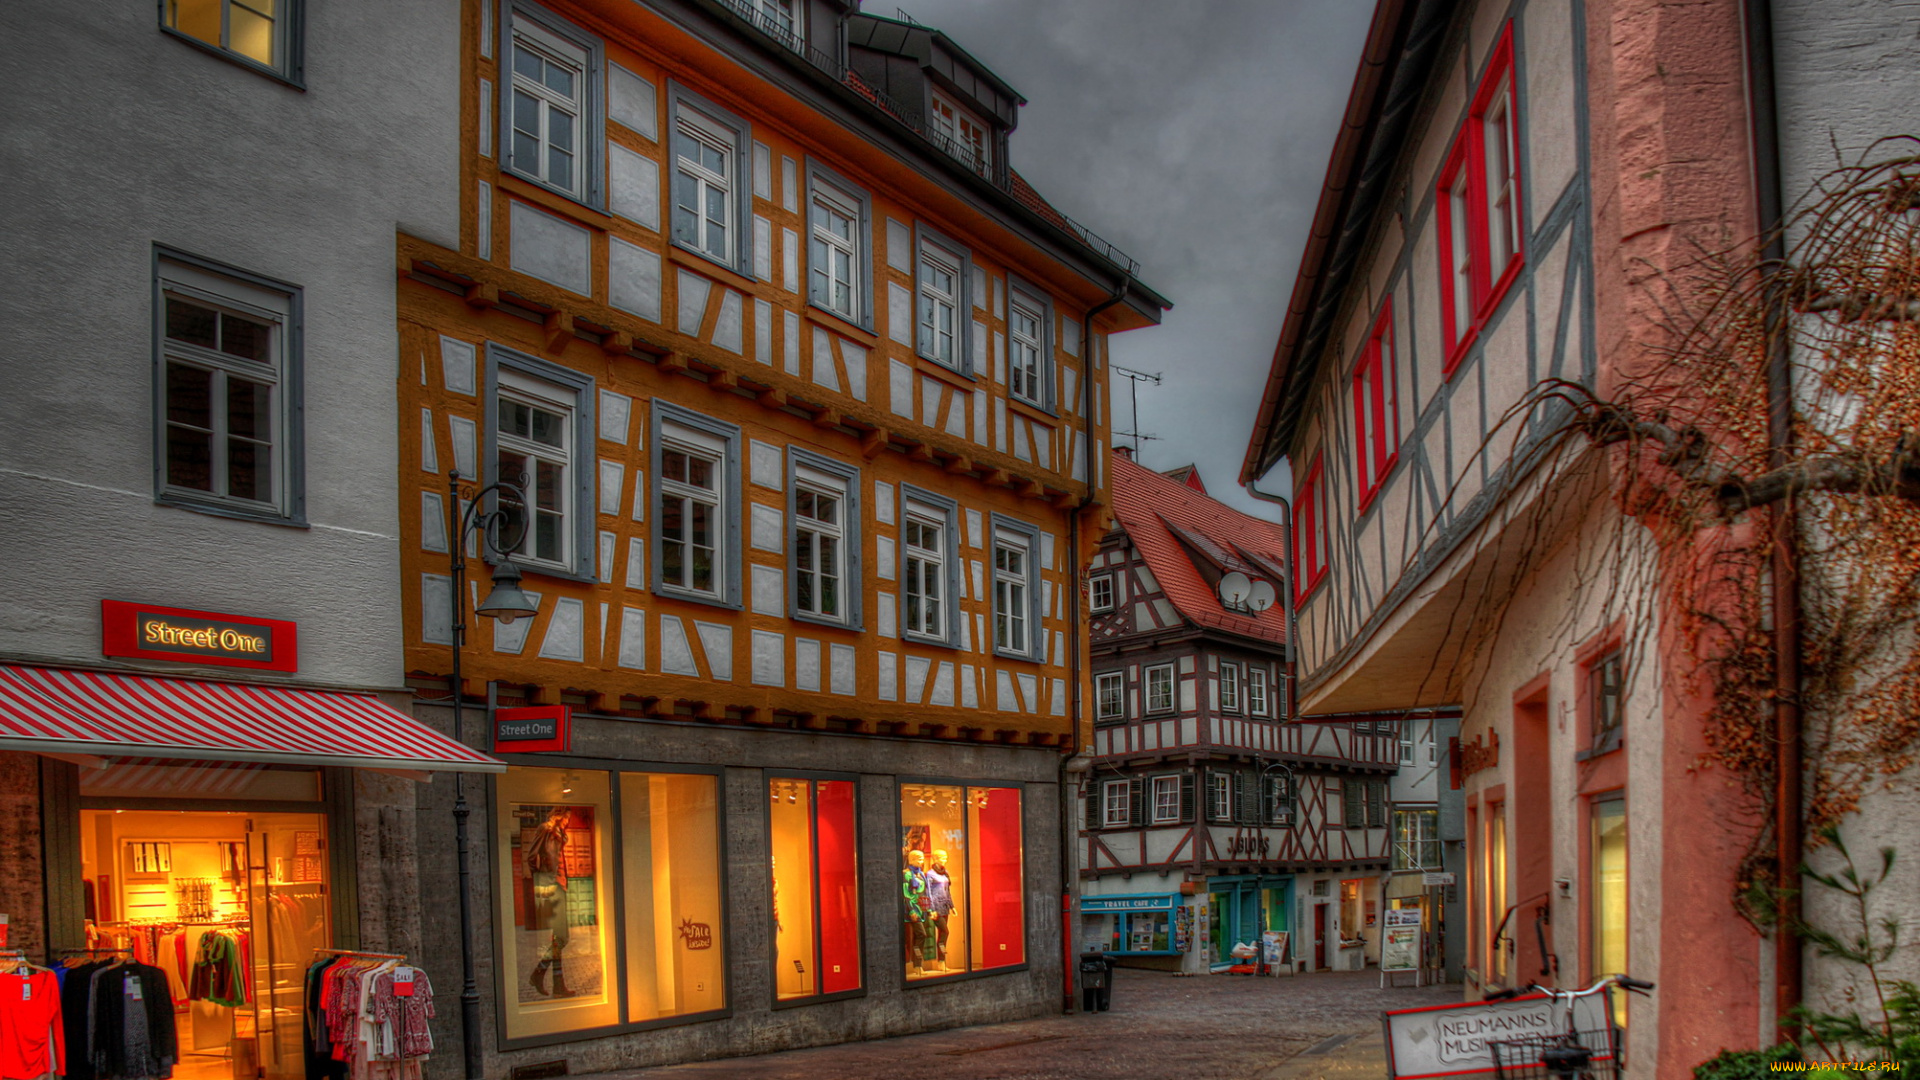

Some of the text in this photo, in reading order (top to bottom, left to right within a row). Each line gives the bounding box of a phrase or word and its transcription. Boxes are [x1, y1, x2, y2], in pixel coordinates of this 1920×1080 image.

[145, 620, 266, 653] Street One
[500, 723, 553, 736] Street One
[1104, 900, 1131, 908] TRAVEL
[1443, 1012, 1548, 1037] NEUMANNS
[1445, 1030, 1549, 1055] MUSIKADEN
